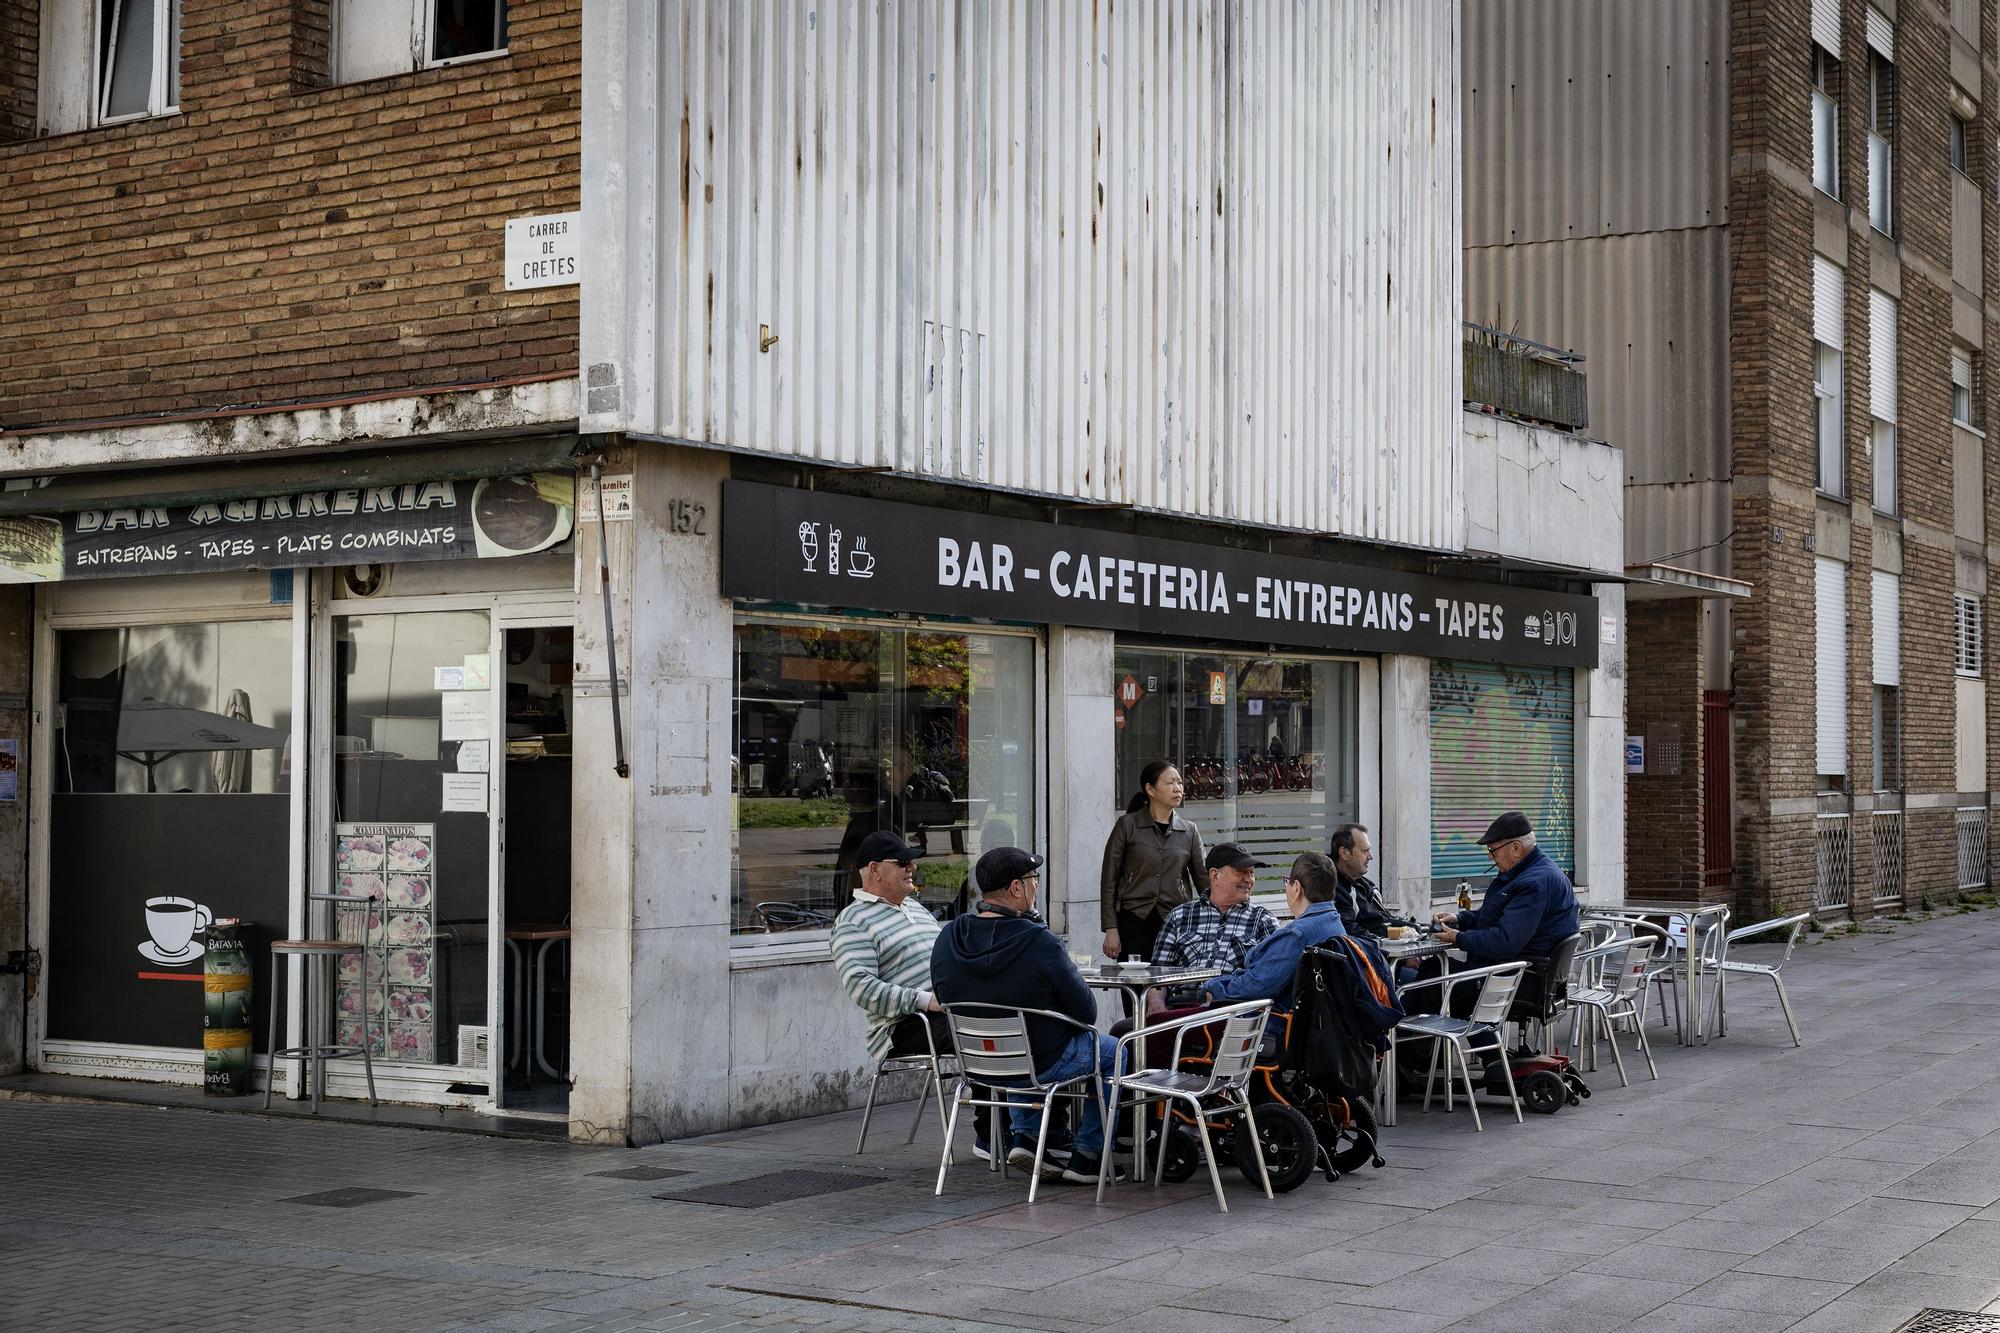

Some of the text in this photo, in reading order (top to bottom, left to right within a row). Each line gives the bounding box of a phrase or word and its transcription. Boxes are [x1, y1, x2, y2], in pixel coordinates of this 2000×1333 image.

[529, 221, 568, 238] CARRER
[542, 241, 555, 254] DE
[523, 256, 575, 280] CRETES
[668, 499, 706, 536] 152
[76, 544, 178, 566] ENTREPANS
[199, 538, 255, 560] TAPES
[277, 533, 334, 555] PLATS
[340, 526, 456, 549] COMBINATS
[938, 537, 1015, 593] BAR
[1049, 550, 1230, 614] CAFETERIA
[1255, 576, 1413, 632] ENTREPANS
[1435, 598, 1504, 641] TAPES
[1123, 683, 1136, 700] M
[353, 825, 416, 835] COMBINADOS
[208, 938, 244, 950] BATAVIA
